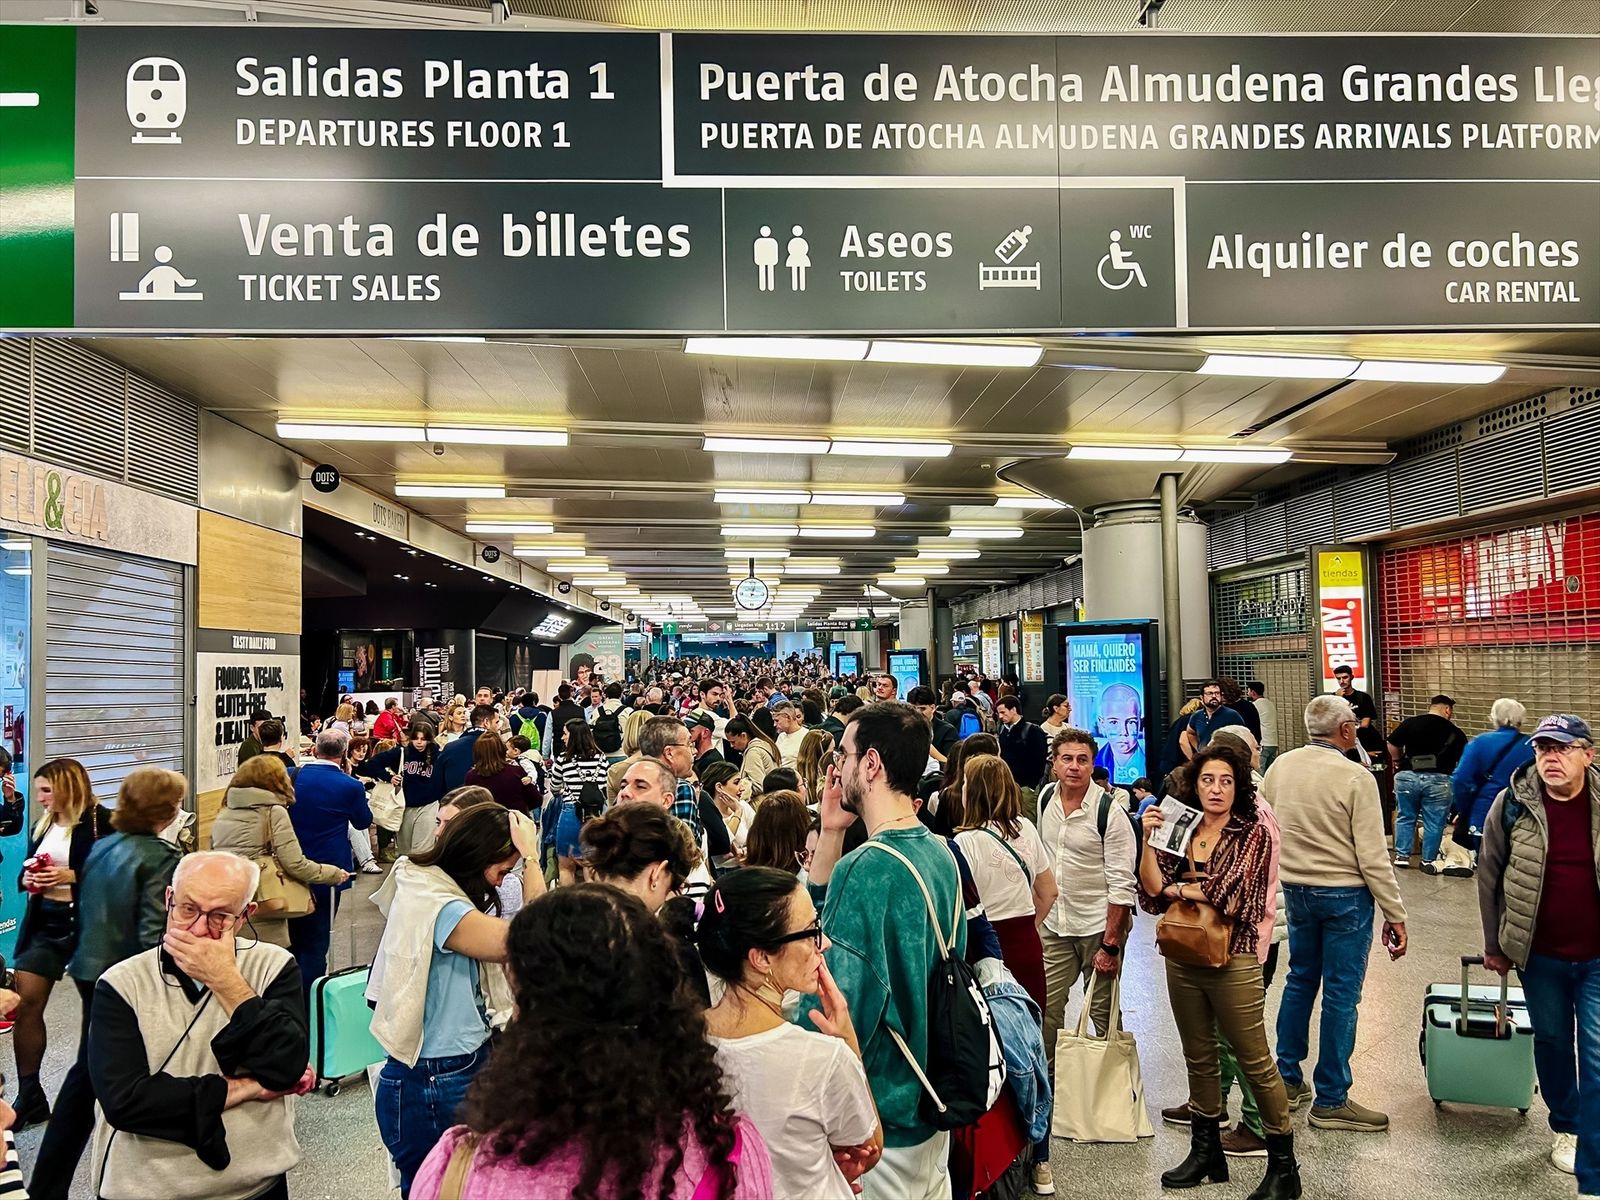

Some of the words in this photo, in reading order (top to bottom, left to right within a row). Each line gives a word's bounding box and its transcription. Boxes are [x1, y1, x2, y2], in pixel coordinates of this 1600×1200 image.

[236, 56, 404, 99] Salidas
[424, 60, 570, 100] Planta
[589, 62, 615, 100] 1
[700, 63, 846, 103] Puerta
[863, 63, 919, 103] de
[933, 64, 1084, 103] Atocha
[1100, 65, 1324, 104] Almudena
[1342, 64, 1519, 104] Grandes
[236, 119, 435, 148] DEPARTURES
[446, 121, 543, 149] FLOOR
[553, 122, 571, 148] 1
[701, 122, 815, 150] PUERTA
[825, 123, 863, 149] DE
[871, 123, 986, 150] ATOCHA
[995, 123, 1159, 151] ALMUDENA
[1168, 123, 1306, 151] GRANDES
[1314, 123, 1453, 150] ARRIVALS
[238, 212, 394, 257] Venta
[416, 213, 480, 257] de
[502, 211, 691, 258] billetes
[840, 225, 953, 259] Aseos
[1129, 225, 1152, 239] WC
[1207, 231, 1370, 278] Alquiler
[1382, 232, 1432, 269] de
[1446, 232, 1580, 269] coches
[238, 274, 344, 302] TICKET
[351, 274, 441, 302] SALES
[840, 270, 927, 292] TOILETS
[1445, 281, 1491, 303] CAR
[1496, 281, 1580, 303] RENTAL
[315, 472, 335, 483] DOTS
[1323, 569, 1358, 578] tiendas
[441, 648, 450, 673] QUALITY
[1073, 642, 1101, 658] MAMÁ,
[1103, 643, 1135, 658] QUIERO
[423, 647, 441, 702] ADITION
[1073, 659, 1090, 672] SER
[1090, 656, 1136, 672] FINLANDÉS
[216, 666, 252, 692] FOODIES,
[253, 666, 284, 691] VEGANS,
